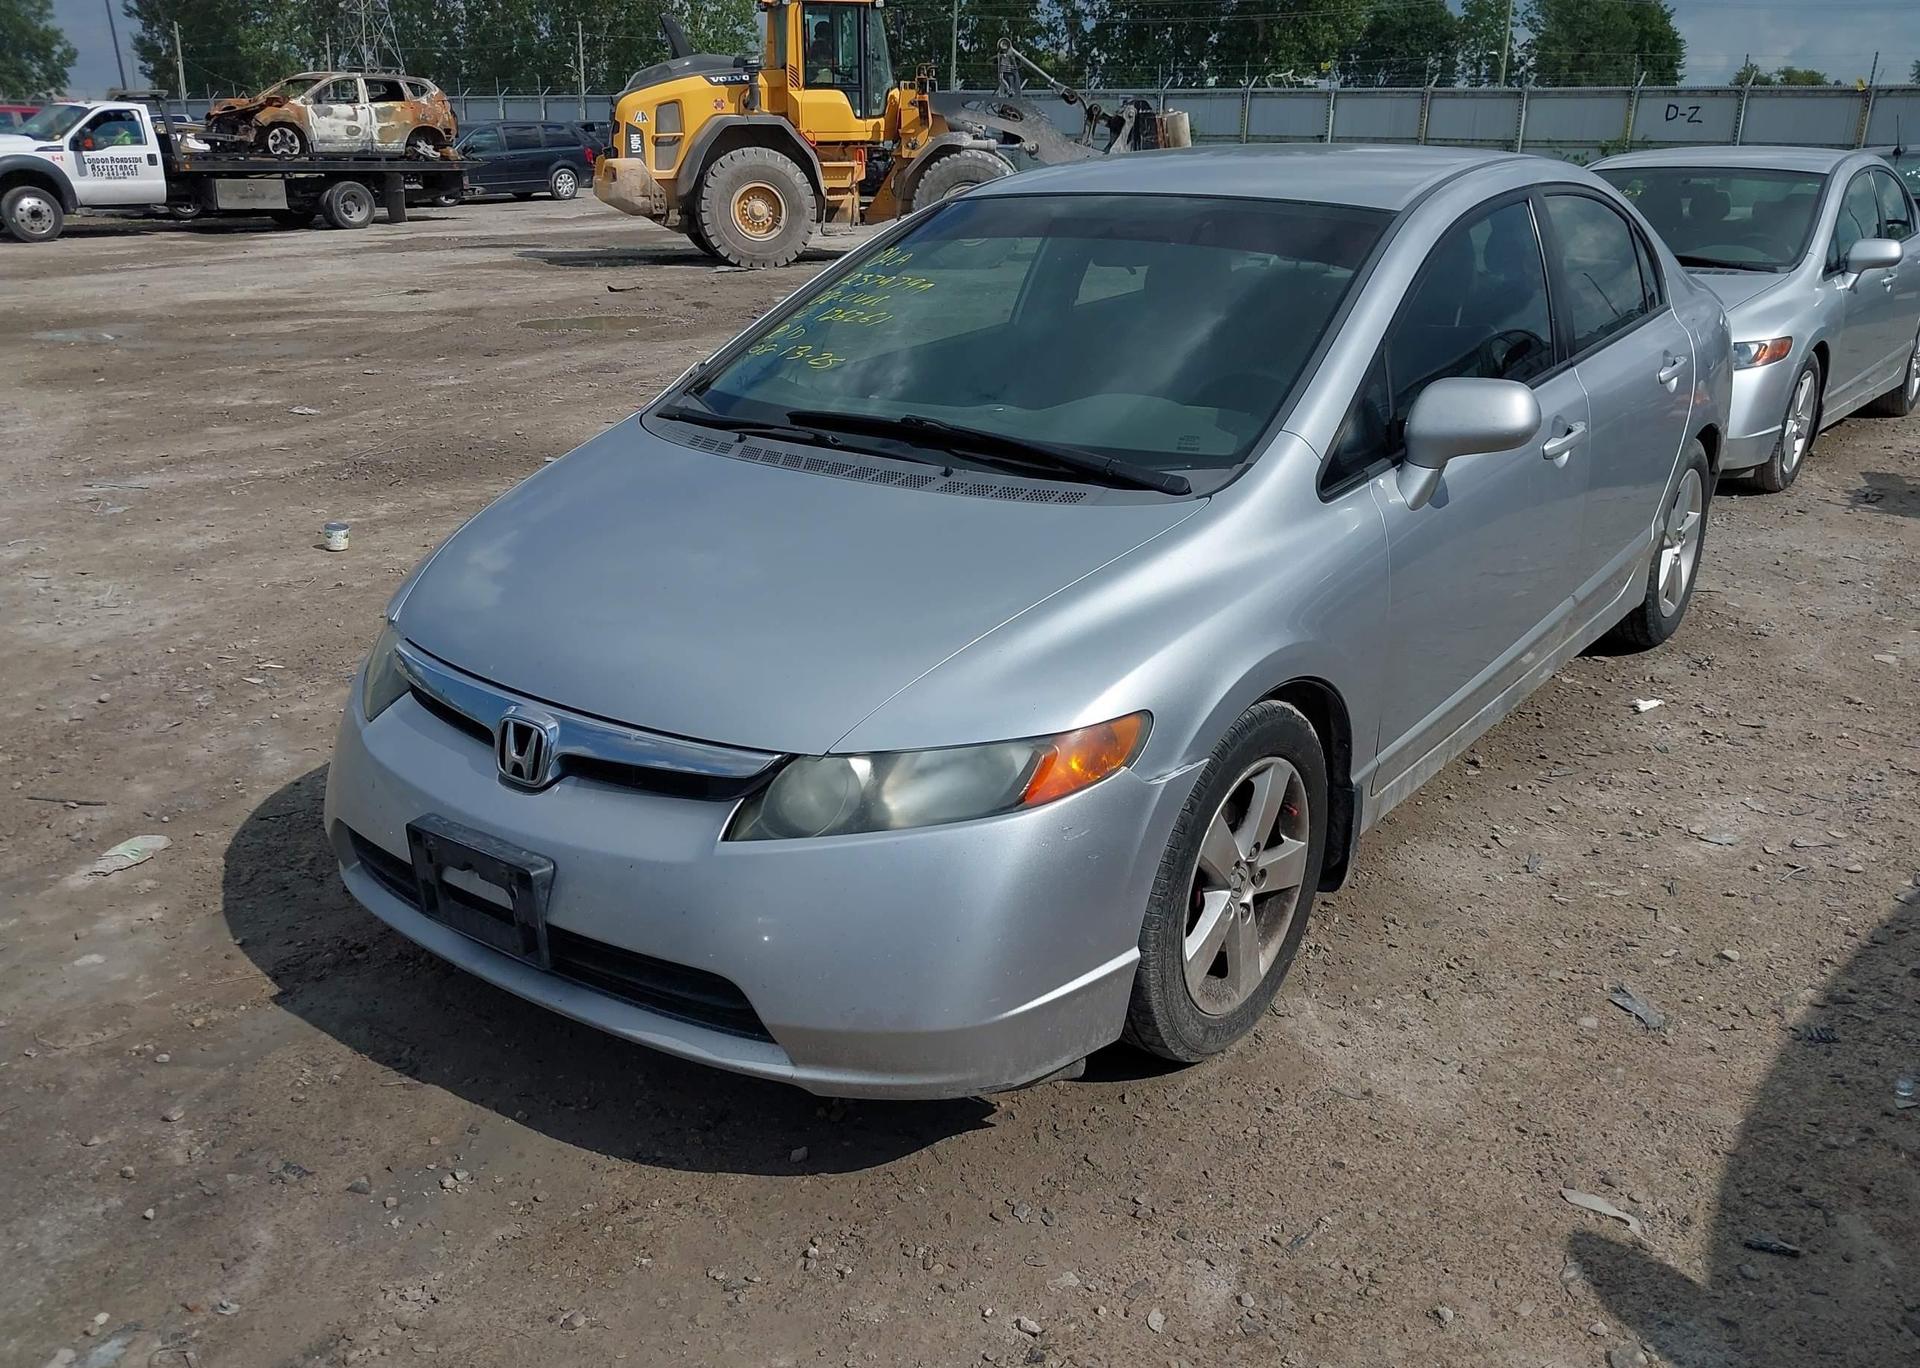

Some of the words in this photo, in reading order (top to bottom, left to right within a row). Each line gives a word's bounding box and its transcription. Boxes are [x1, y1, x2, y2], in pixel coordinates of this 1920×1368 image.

[710, 75, 750, 83] VOLVO
[1664, 103, 1703, 123] D-Z
[630, 134, 642, 153] L90H
